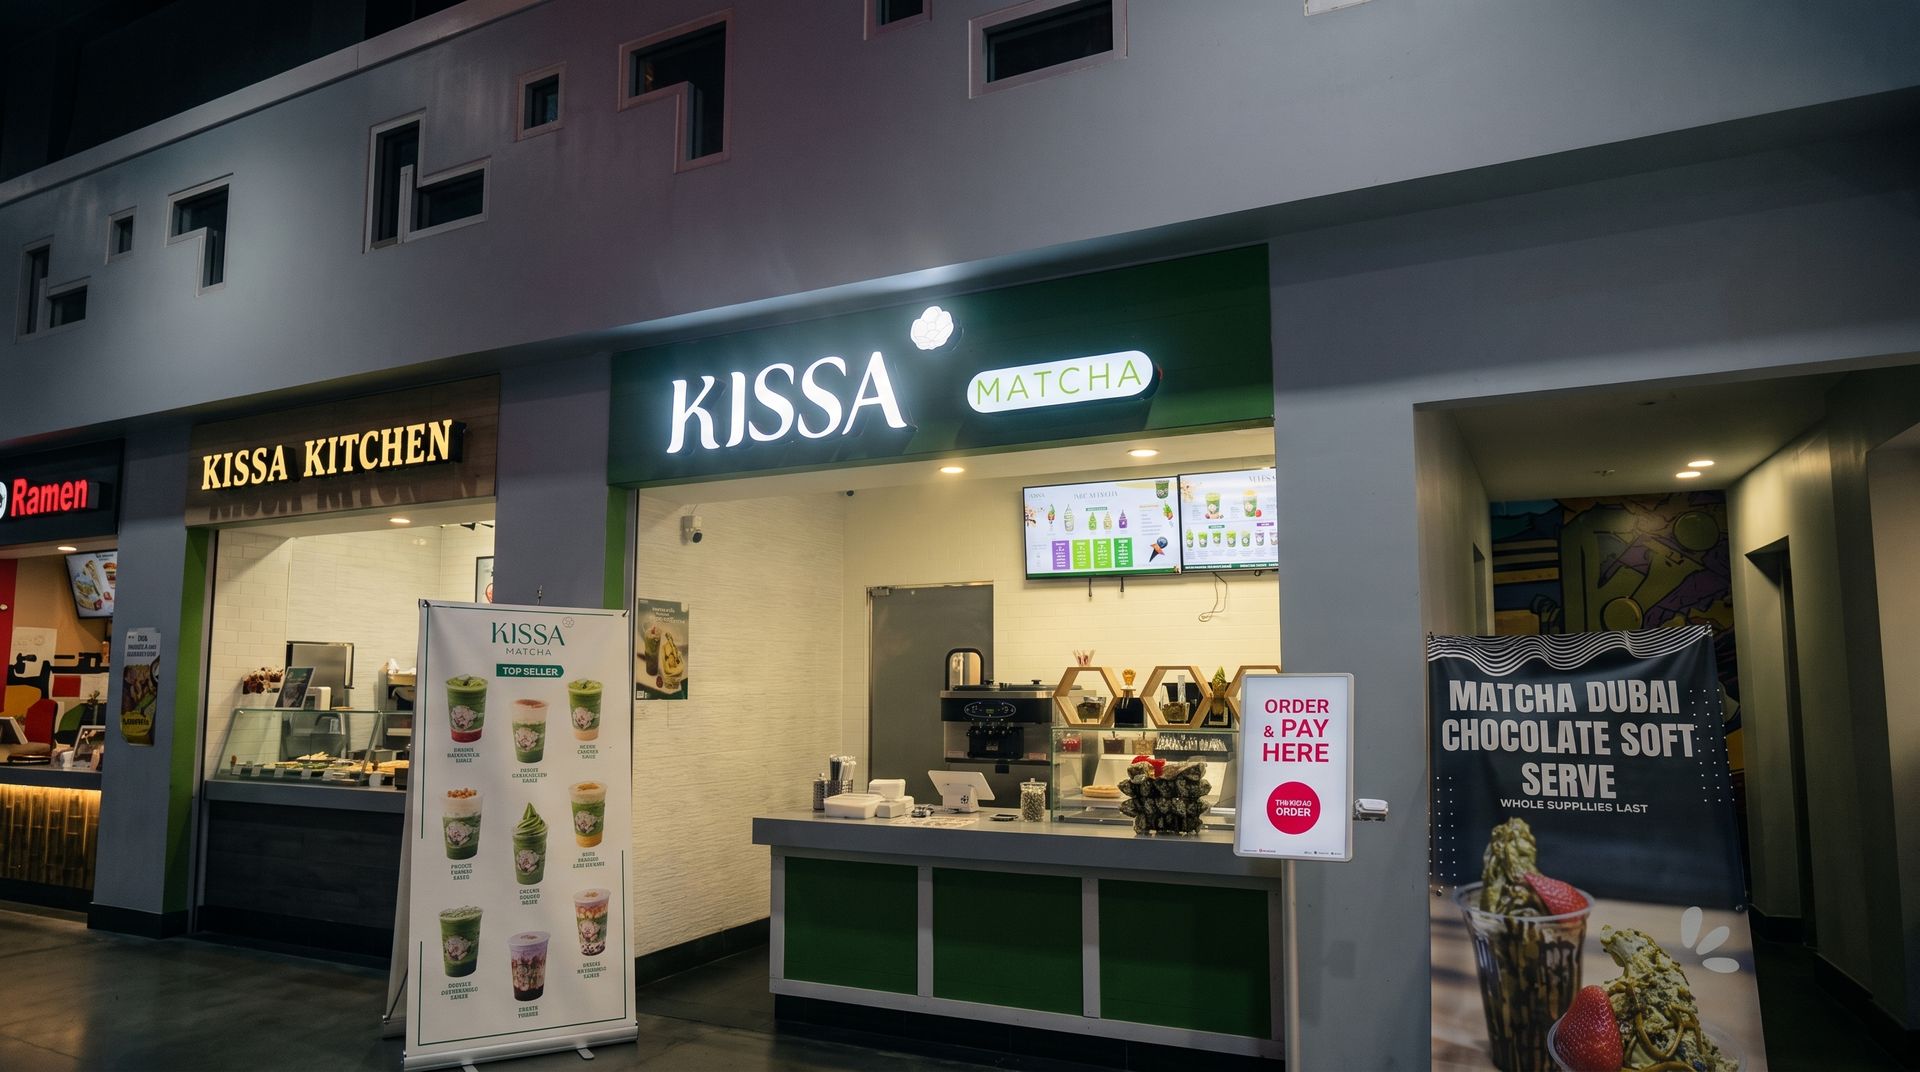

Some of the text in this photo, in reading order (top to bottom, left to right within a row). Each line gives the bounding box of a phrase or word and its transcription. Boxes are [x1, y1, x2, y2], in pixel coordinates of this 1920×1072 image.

[976, 360, 1142, 405] MATCHA
[666, 351, 907, 454] KISSA
[201, 419, 453, 490] KISSA KITCHEN
[11, 478, 88, 517] Ramen
[491, 622, 565, 646] KISSA
[505, 647, 552, 656] MATCHA
[502, 666, 559, 677] TOP SELLER
[1265, 699, 1330, 714] ORDER
[1449, 680, 1680, 714] MATCHA DUBAI
[1263, 718, 1330, 738] & PAY
[1442, 718, 1695, 757] CHOCOLATE SOFT
[1262, 742, 1330, 763] HERE
[1521, 762, 1617, 799] SERVE
[1275, 808, 1311, 817] ORDER
[1500, 799, 1544, 809] WHOLE
[1616, 803, 1648, 813] LAST
